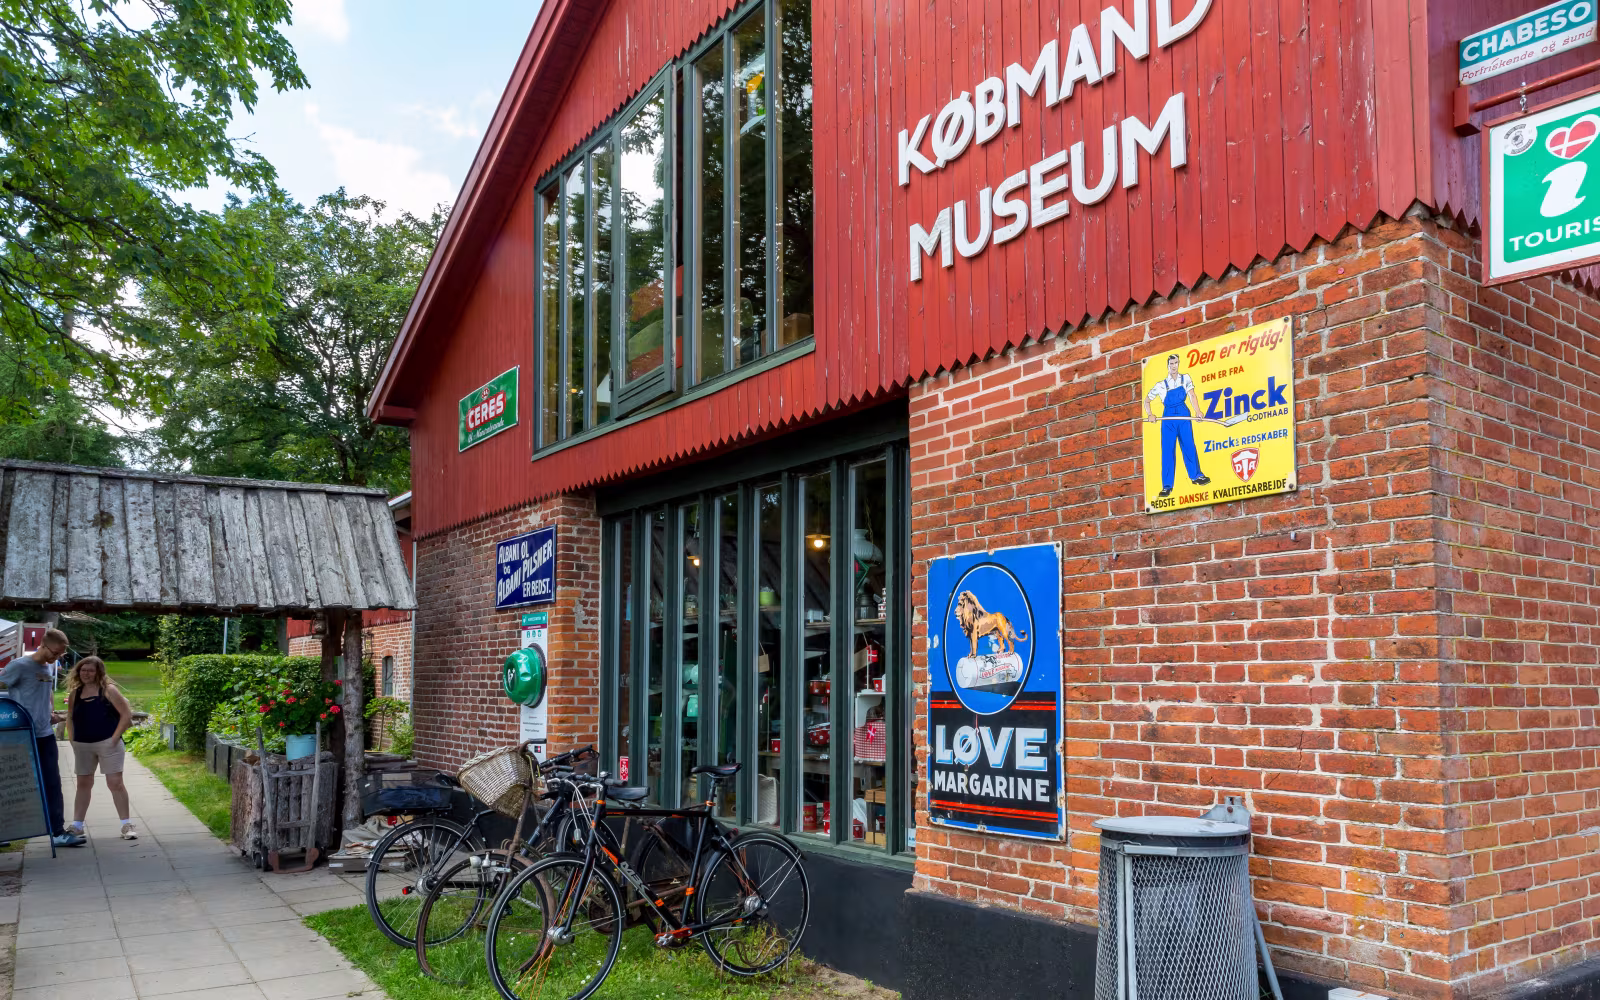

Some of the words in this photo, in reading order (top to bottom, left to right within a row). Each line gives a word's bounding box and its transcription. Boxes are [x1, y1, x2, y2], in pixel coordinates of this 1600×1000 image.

[1462, 1, 1592, 62] CHABESO
[1461, 50, 1535, 81] Forfriskende
[1541, 40, 1556, 53] og
[1562, 27, 1594, 46] sund
[898, 0, 1213, 187] KØBMAND
[909, 91, 1187, 282] MUSEUM
[1187, 348, 1216, 369] Den
[1219, 342, 1236, 360] er
[1237, 324, 1288, 356] rigtig!
[1201, 372, 1217, 383] DEN
[1218, 370, 1227, 379] ER
[1229, 365, 1245, 376] FRA
[468, 393, 504, 429] CERES
[1203, 375, 1288, 420] Zinck
[1246, 407, 1288, 422] GODTHAAB
[1241, 428, 1288, 446] REDSKABER
[1179, 491, 1209, 505] DANSKE
[1213, 478, 1287, 500] KVALITETSARBEJDE
[497, 567, 522, 606] ALBANI
[522, 539, 553, 582] PILSNER
[498, 543, 520, 564] ALBANI
[522, 581, 531, 598] ER
[935, 724, 1048, 772] LØVE
[934, 770, 1050, 803] MARGARINE
